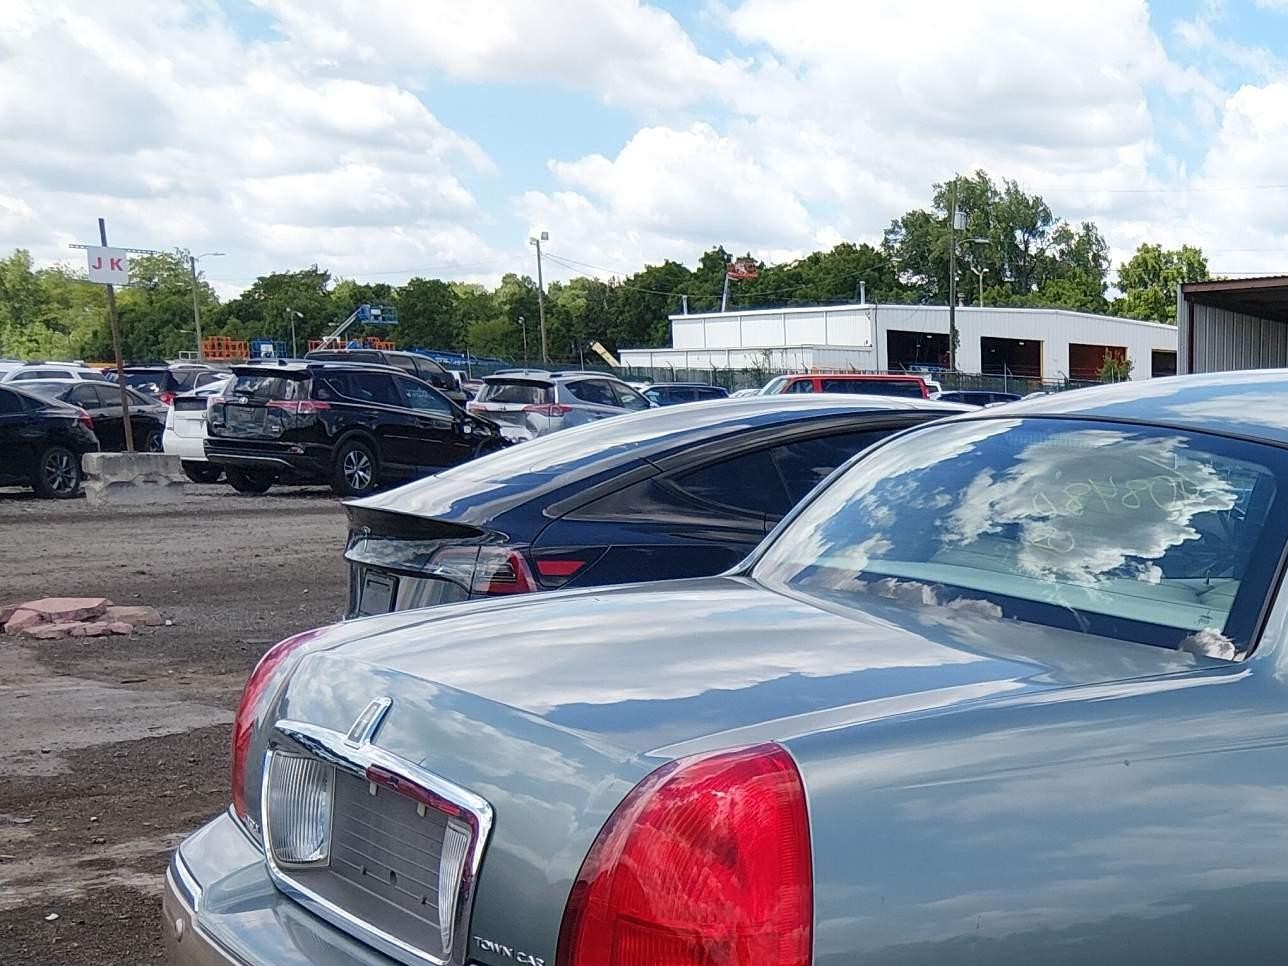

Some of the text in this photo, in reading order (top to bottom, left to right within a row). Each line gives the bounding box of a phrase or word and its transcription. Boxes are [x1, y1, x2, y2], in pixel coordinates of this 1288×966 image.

[92, 256, 123, 271] J K
[473, 935, 513, 958] TOWN
